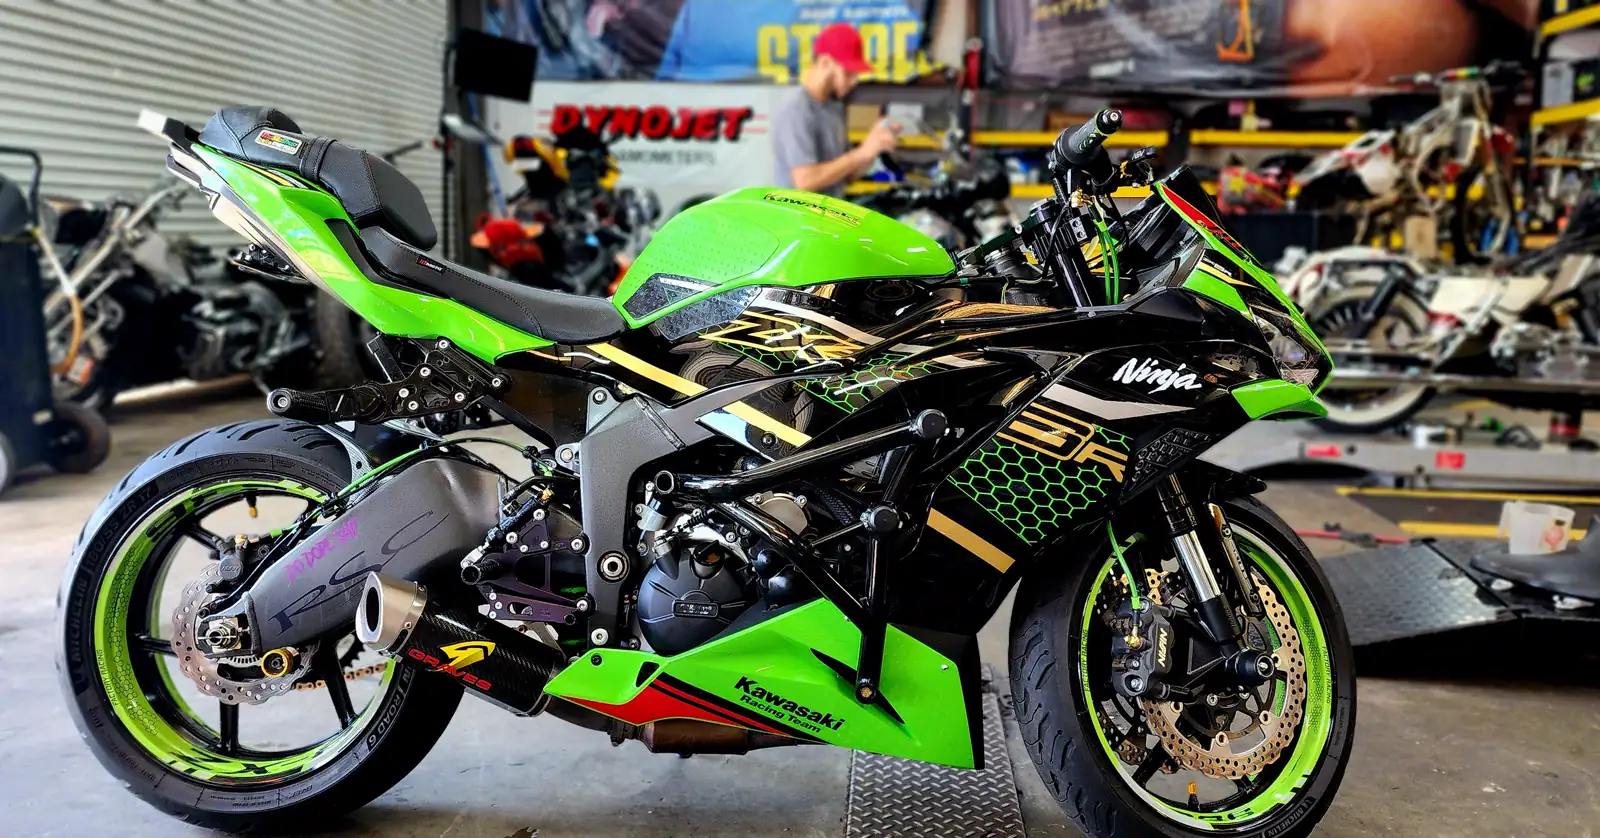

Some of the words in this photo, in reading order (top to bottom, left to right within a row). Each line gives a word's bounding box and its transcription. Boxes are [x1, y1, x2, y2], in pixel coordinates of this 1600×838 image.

[550, 104, 754, 142] DYNOJET
[763, 192, 860, 225] Kawasaki
[1112, 357, 1202, 394] Ninja
[96, 649, 106, 675] RACING
[408, 648, 492, 691] GRAVES
[103, 677, 118, 706] FACTORY
[734, 676, 846, 731] Kawasaki
[377, 693, 402, 735] ROAD
[740, 694, 785, 719] Racing
[788, 715, 822, 733] Team
[368, 734, 377, 747] 6
[1268, 807, 1304, 837] MICHELIN
